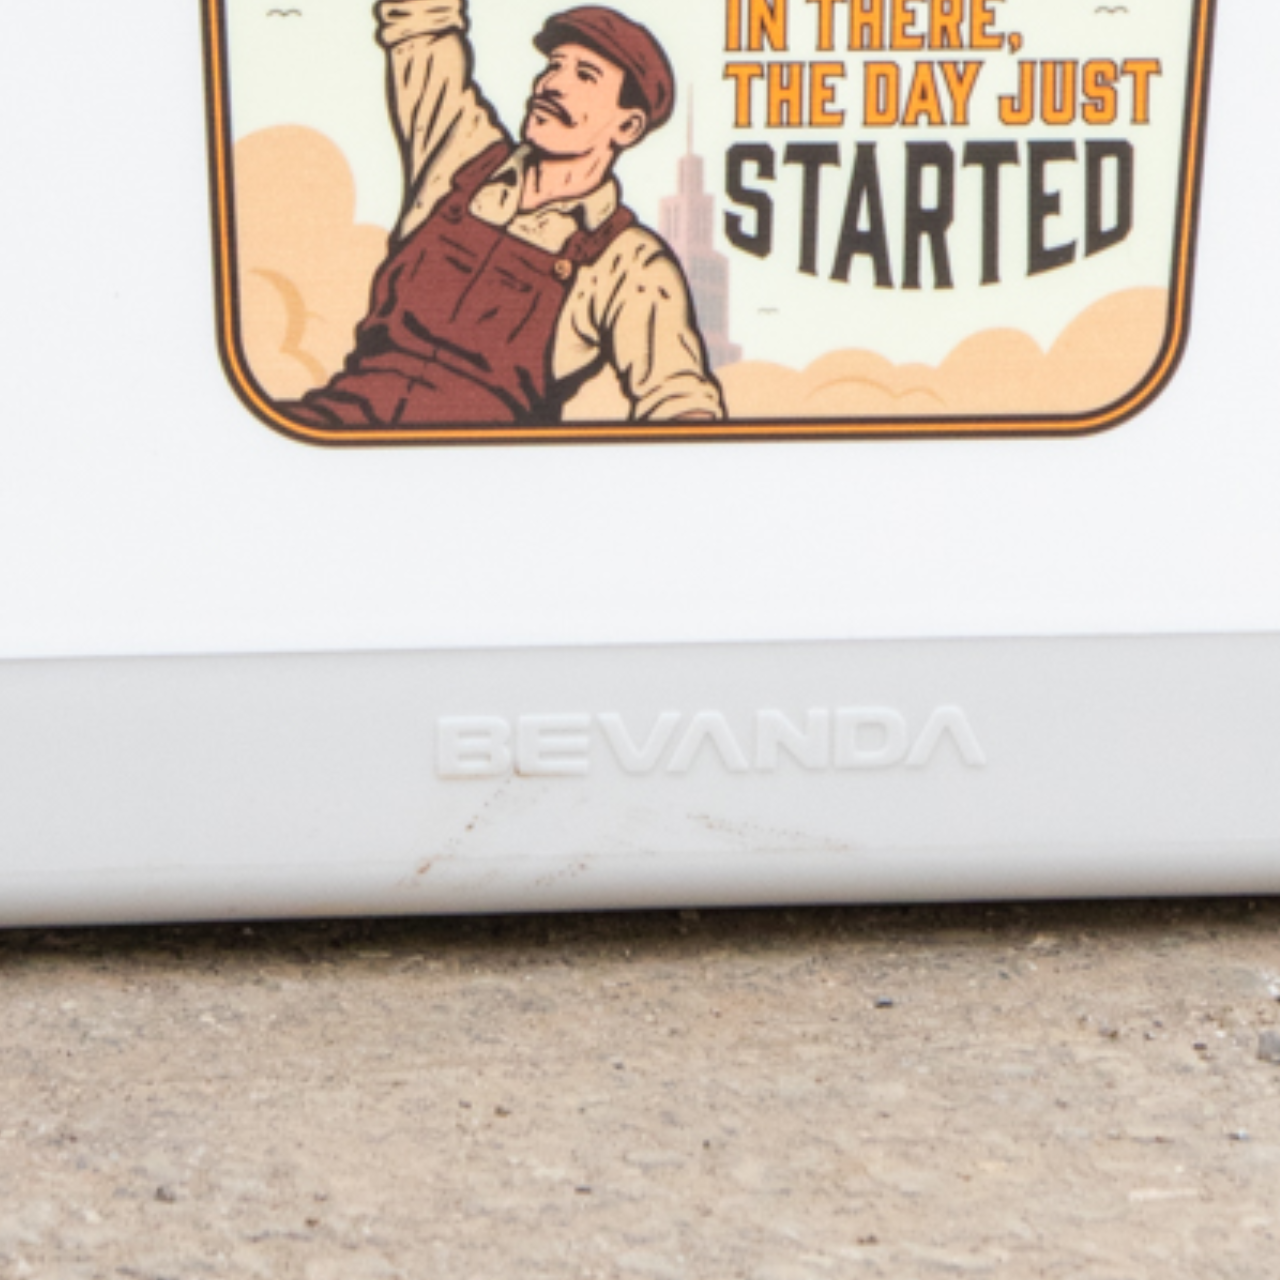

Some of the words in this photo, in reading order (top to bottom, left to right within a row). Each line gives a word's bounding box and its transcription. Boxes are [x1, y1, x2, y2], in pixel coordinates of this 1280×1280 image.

[722, 60, 846, 128] THE
[862, 57, 983, 128] DAY
[996, 56, 1163, 127] JUST
[722, 137, 1135, 290] STARTED
[432, 702, 990, 780] BEVANDA
